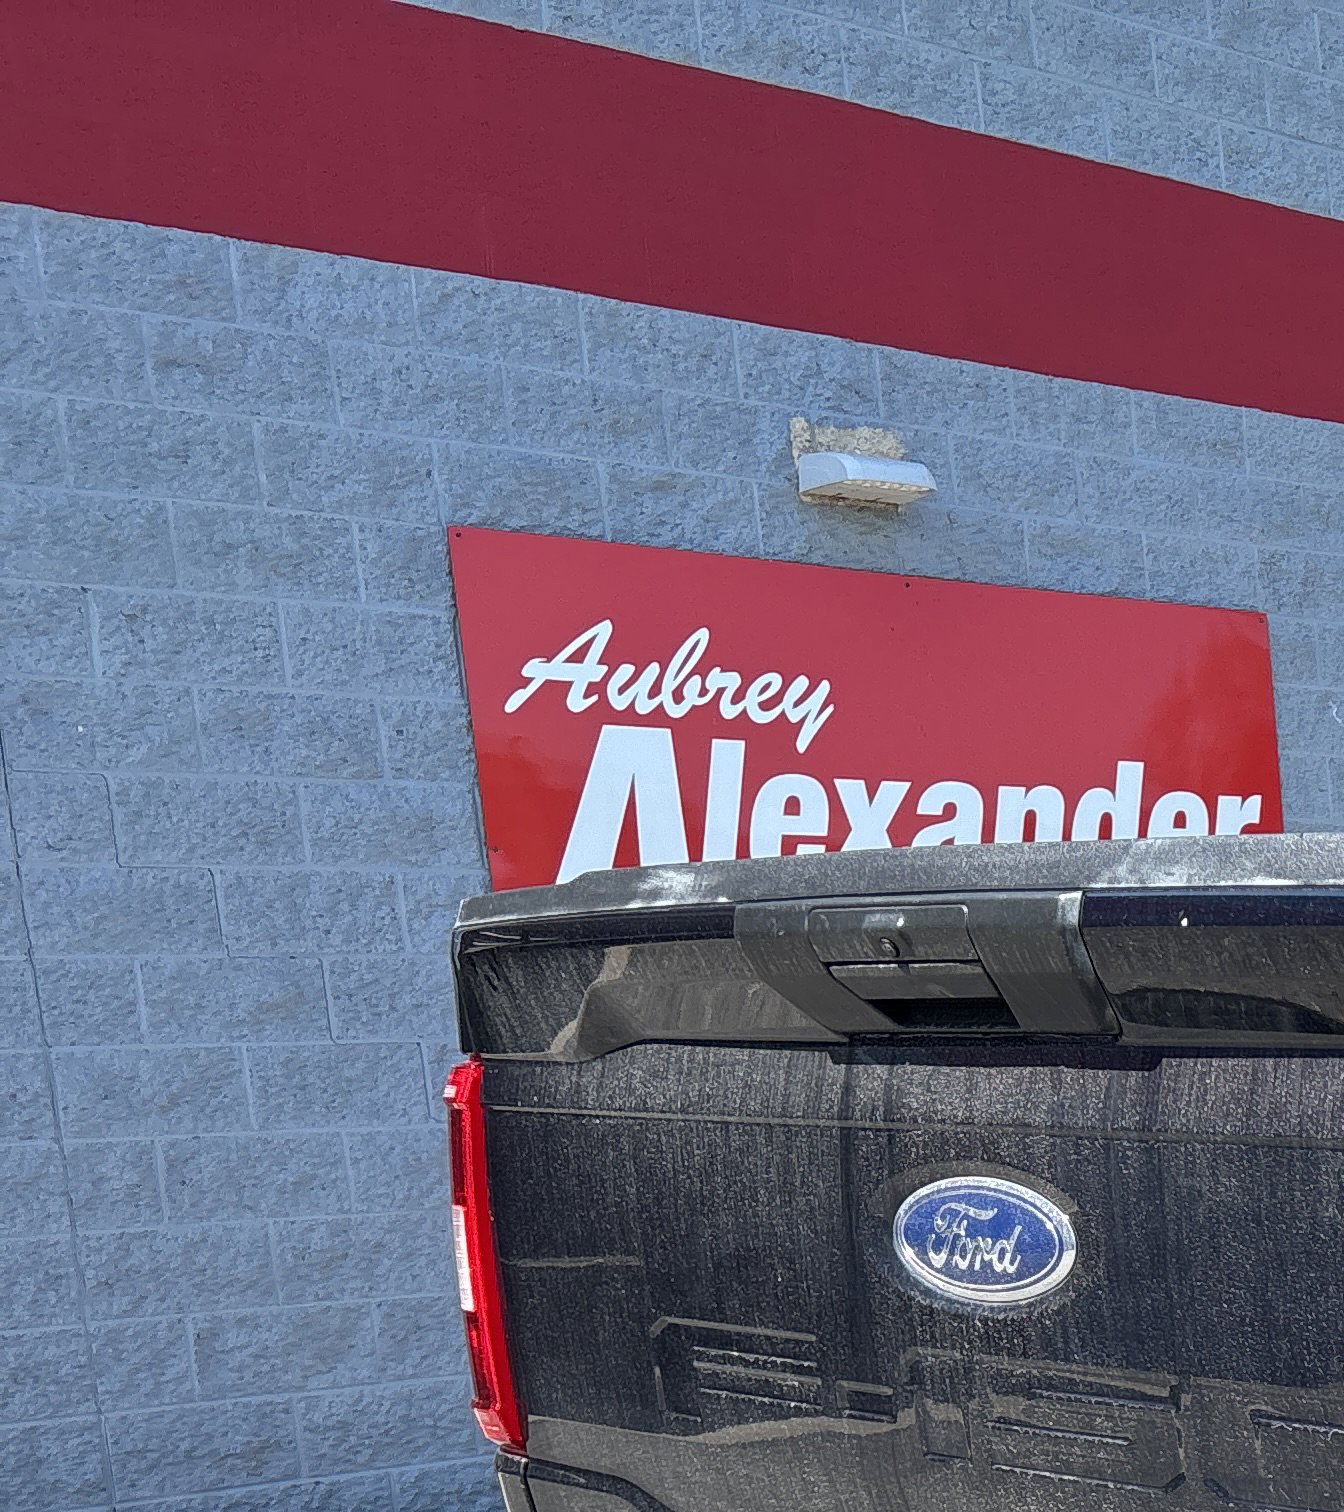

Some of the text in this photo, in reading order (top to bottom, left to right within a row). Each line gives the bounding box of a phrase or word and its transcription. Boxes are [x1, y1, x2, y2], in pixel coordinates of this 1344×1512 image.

[504, 618, 834, 753] Aubrey
[557, 725, 1263, 886] Alexander
[926, 1202, 1022, 1274] Ford
